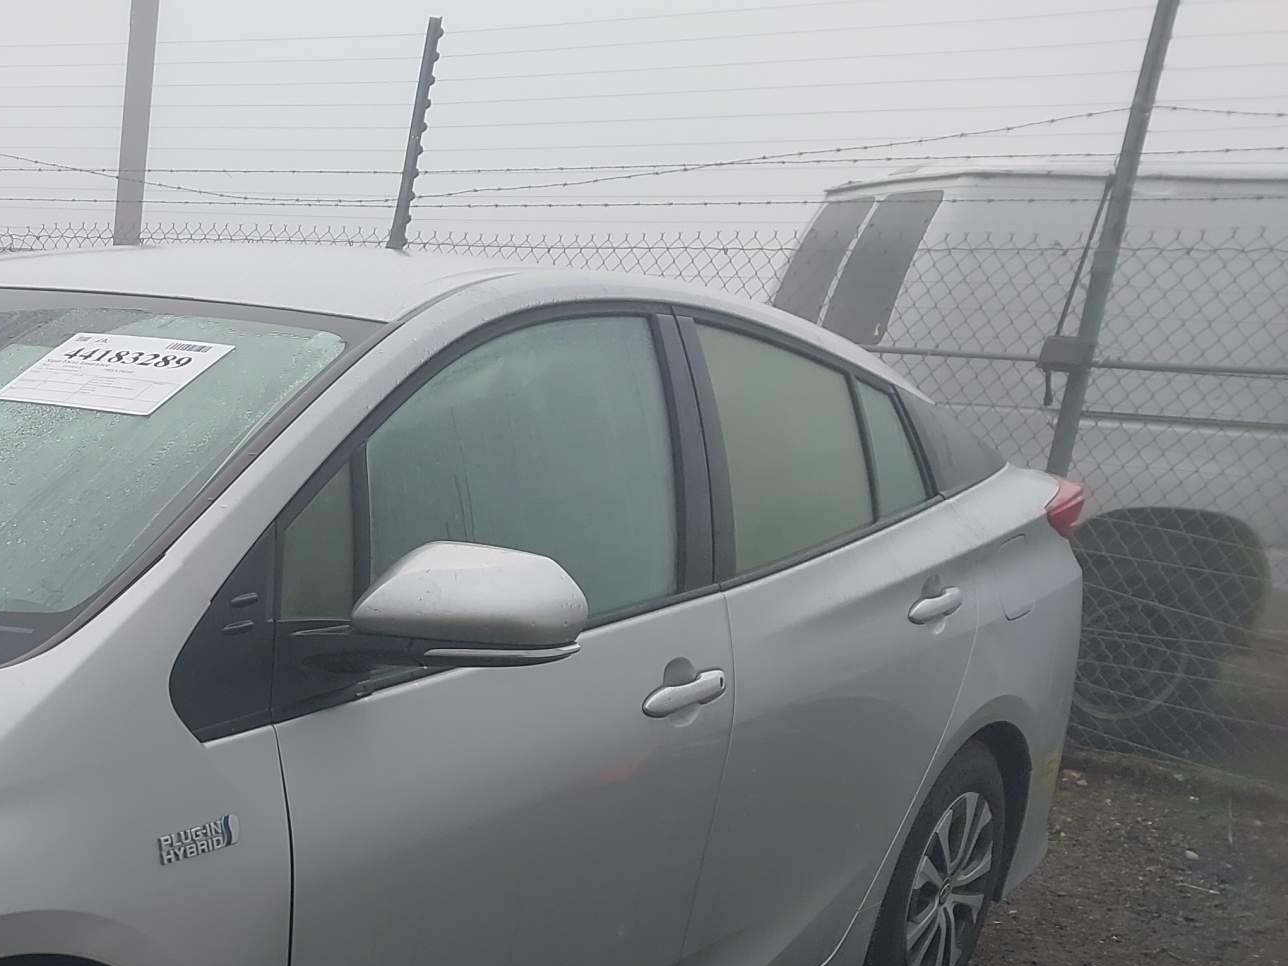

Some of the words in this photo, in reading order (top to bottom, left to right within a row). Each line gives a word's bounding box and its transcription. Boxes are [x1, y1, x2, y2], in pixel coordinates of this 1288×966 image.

[64, 347, 193, 369] 44183289
[159, 820, 222, 848] PLUG-IN
[162, 836, 224, 865] HYBRID
